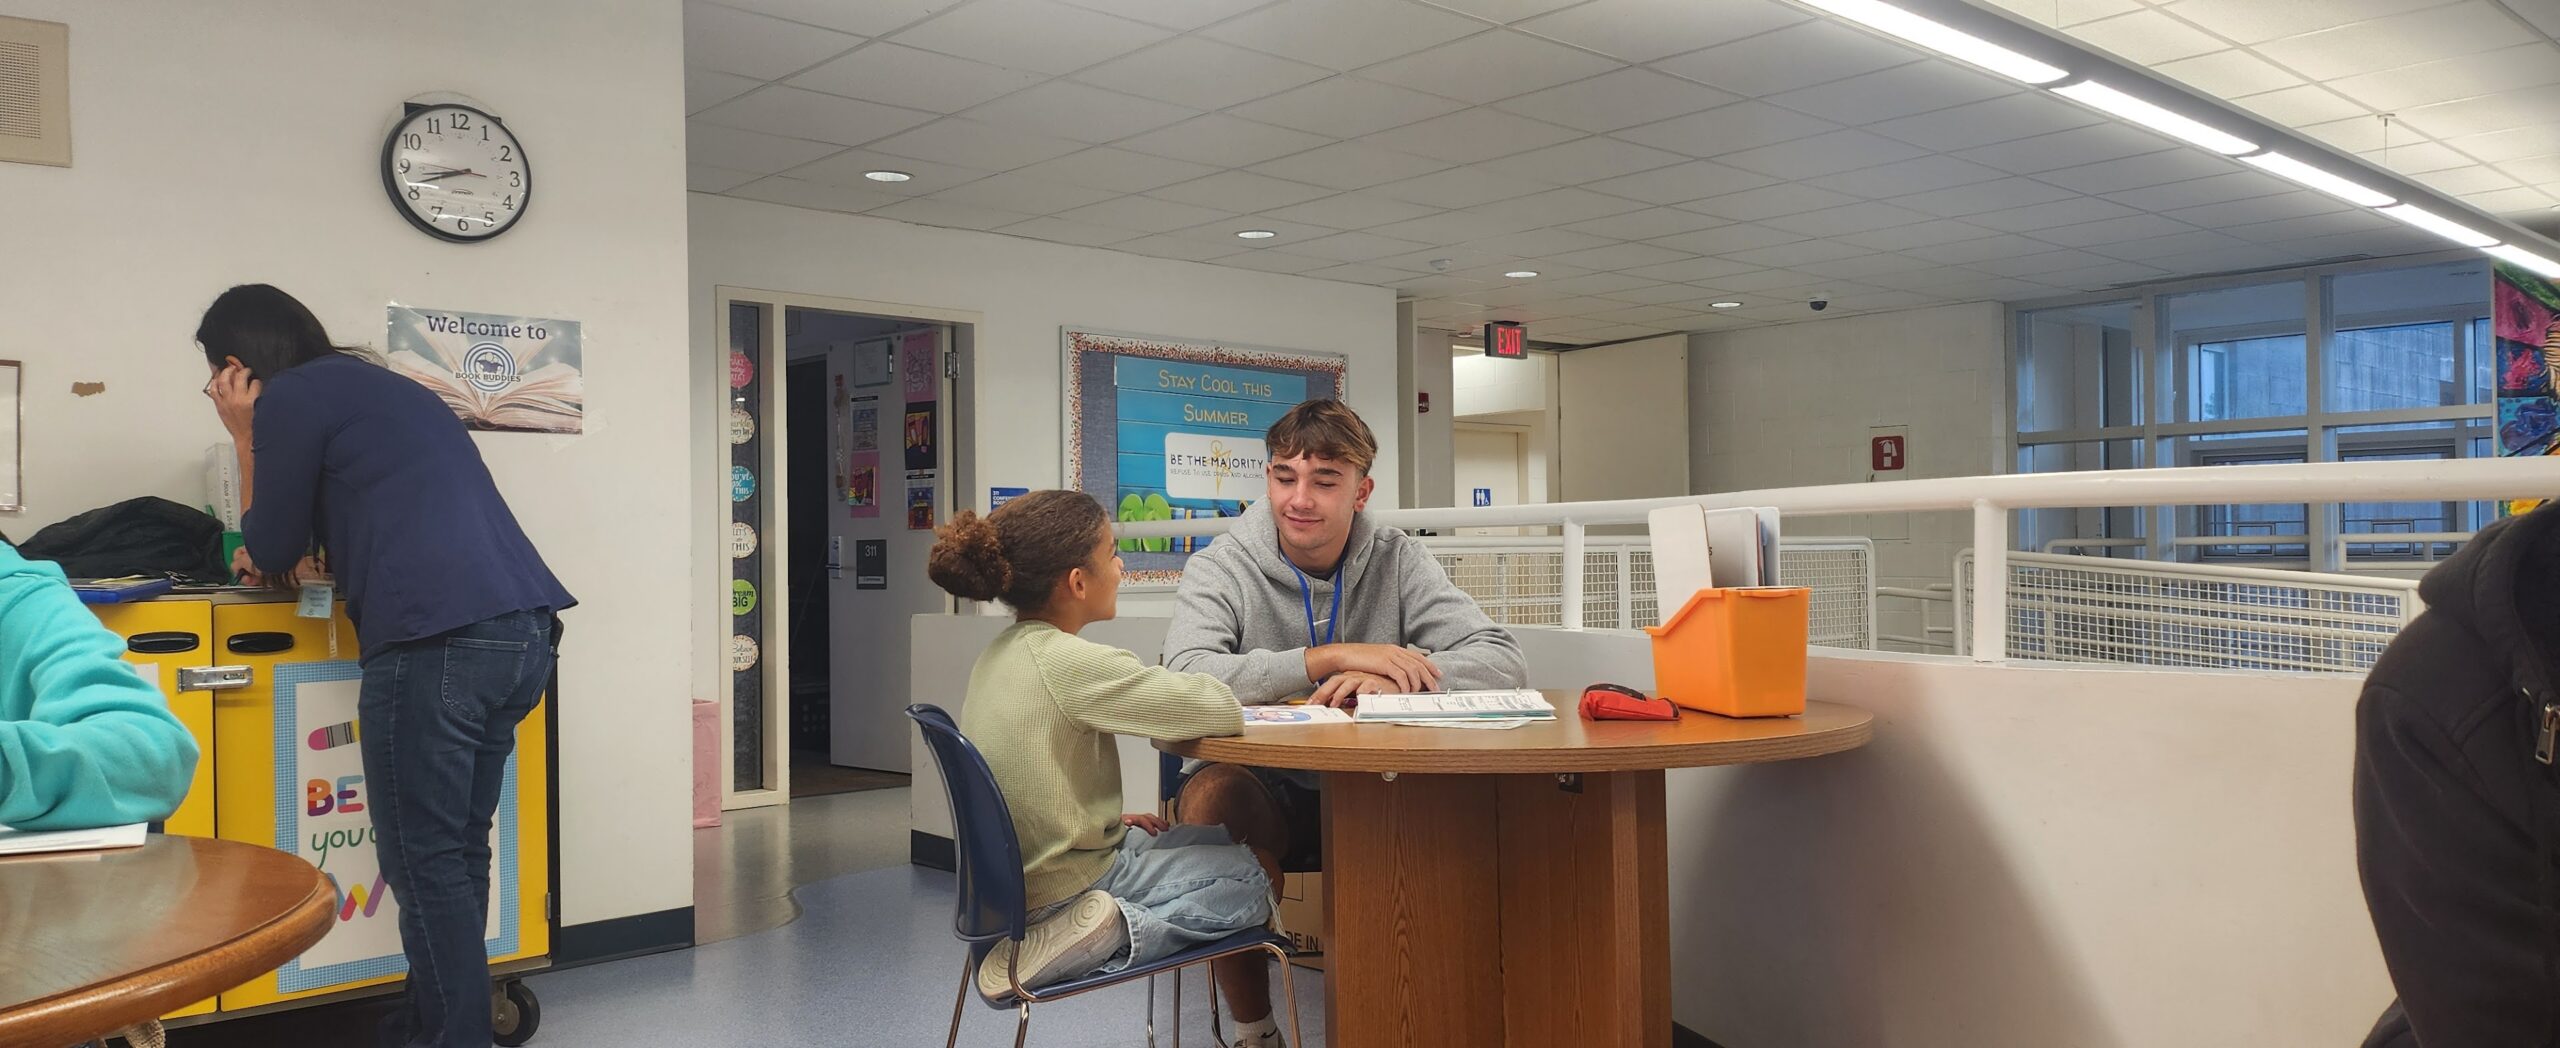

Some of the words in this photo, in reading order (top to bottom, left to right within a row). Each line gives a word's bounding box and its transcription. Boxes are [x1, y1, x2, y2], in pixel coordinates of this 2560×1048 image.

[427, 118, 441, 135] 11
[451, 113, 470, 130] 12
[481, 125, 490, 141] 1
[403, 133, 421, 150] 10
[500, 145, 512, 162] 2
[399, 158, 411, 174] 9
[510, 171, 520, 187] 3
[408, 184, 420, 200] 8
[502, 194, 514, 210] 4
[431, 206, 443, 222] 7
[483, 212, 494, 227] 5
[457, 216, 469, 231] 6
[426, 315, 521, 339] Welcome
[527, 324, 547, 340] to
[1497, 327, 1521, 355] EXIT
[455, 371, 481, 381] BOOK
[483, 373, 521, 383] BUDDIES
[1159, 369, 1196, 390] STAY
[1201, 374, 1238, 395] COOL
[1242, 382, 1272, 397] THIS
[1184, 404, 1249, 426] SUMMER
[1170, 454, 1183, 466] BE
[1187, 455, 1207, 467] THE
[1211, 457, 1264, 469] MAJORITY
[865, 544, 877, 557] 311
[307, 775, 364, 816] BE
[312, 828, 364, 869] you
[1306, 935, 1319, 952] IN
